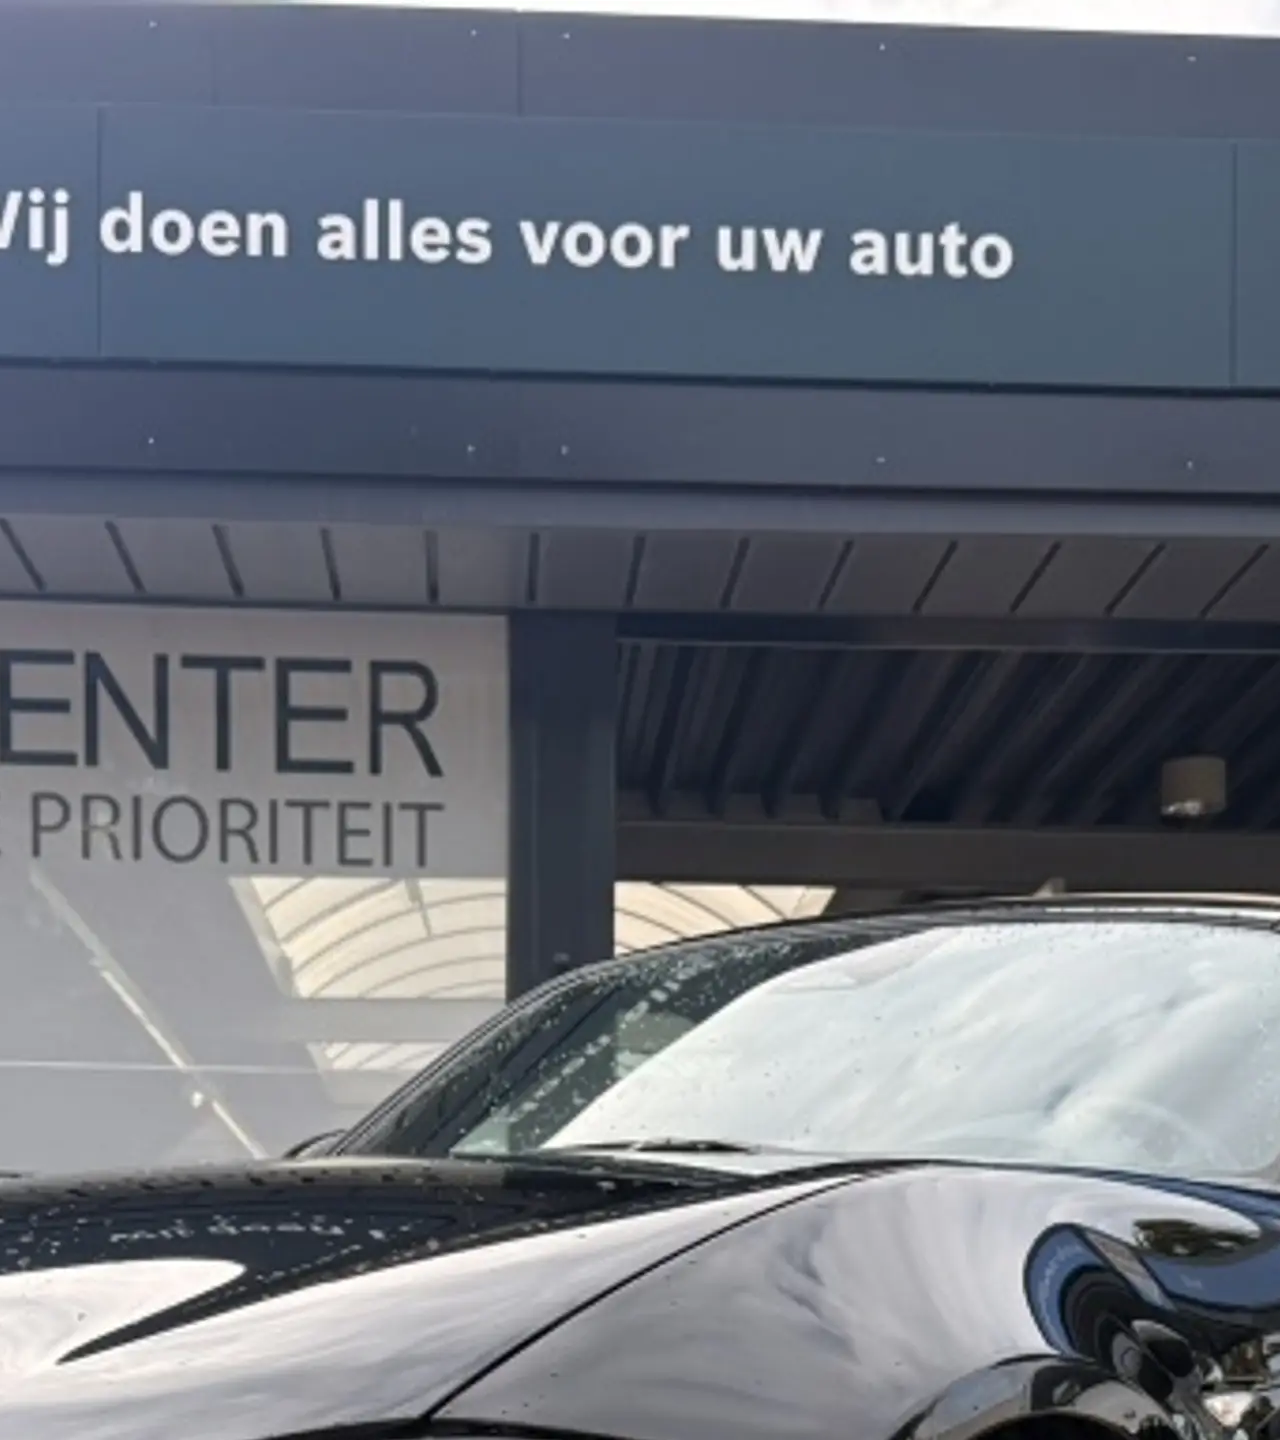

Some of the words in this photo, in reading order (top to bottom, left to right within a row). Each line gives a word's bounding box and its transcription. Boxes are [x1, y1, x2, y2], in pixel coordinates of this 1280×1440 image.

[99, 190, 289, 258] doen
[316, 197, 493, 265] alles
[518, 219, 691, 269] voor
[716, 225, 824, 273] uw
[848, 221, 1015, 279] auto
[30, 792, 446, 869] PRIORITEIT
